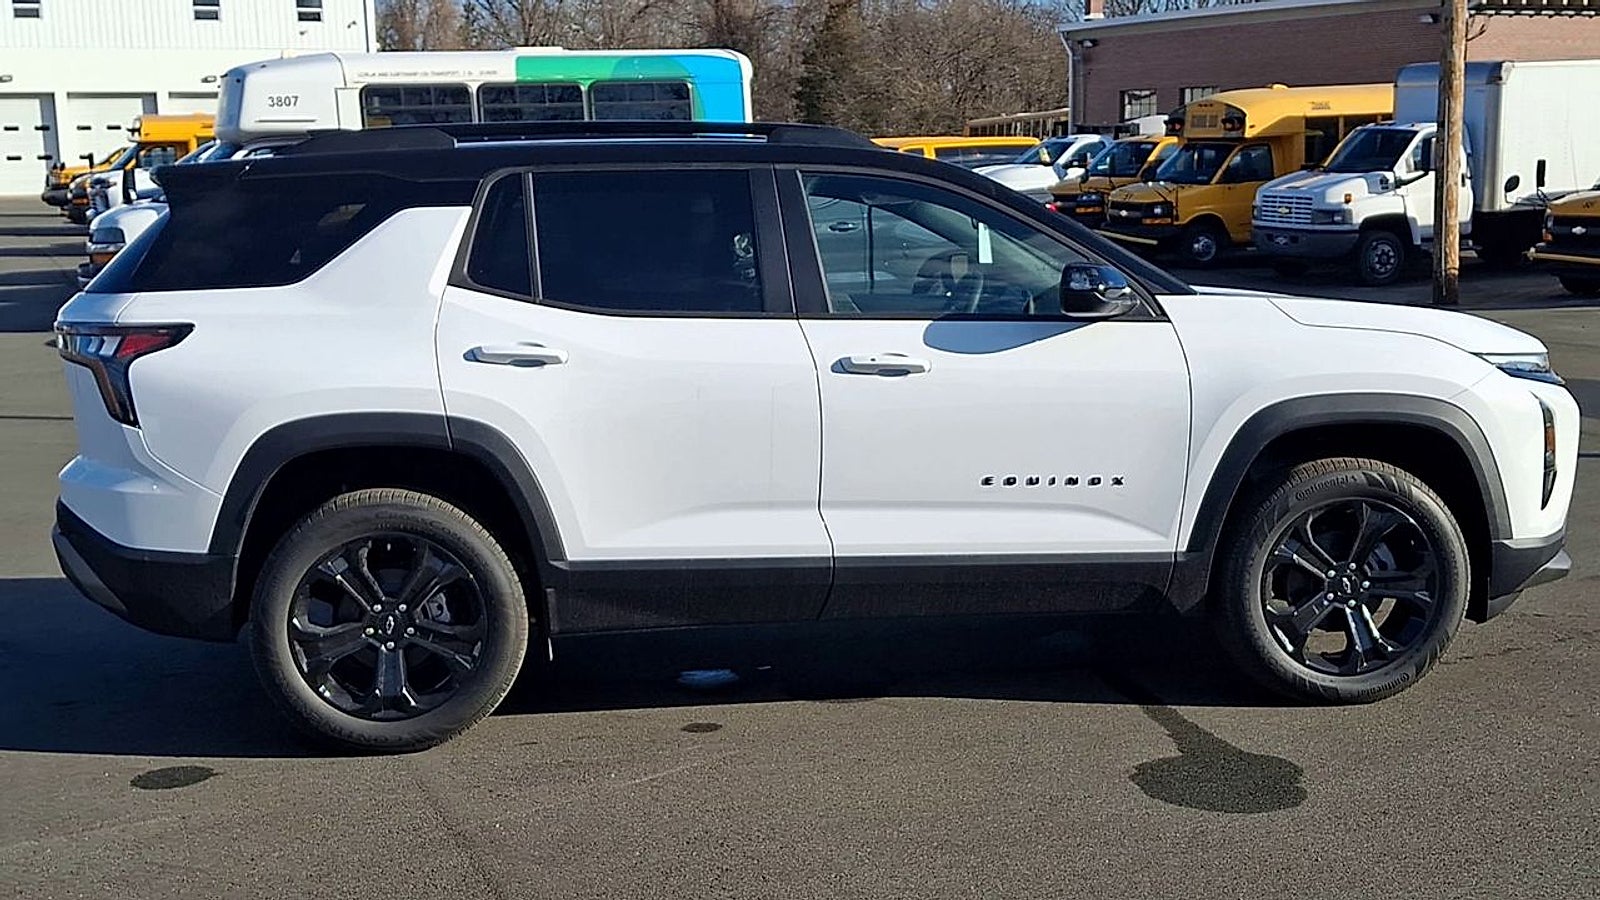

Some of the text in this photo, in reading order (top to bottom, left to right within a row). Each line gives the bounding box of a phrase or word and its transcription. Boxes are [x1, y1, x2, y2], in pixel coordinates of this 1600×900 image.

[267, 95, 299, 107] 3807
[980, 475, 1125, 487] EQUINOX
[1296, 475, 1349, 501] Continental
